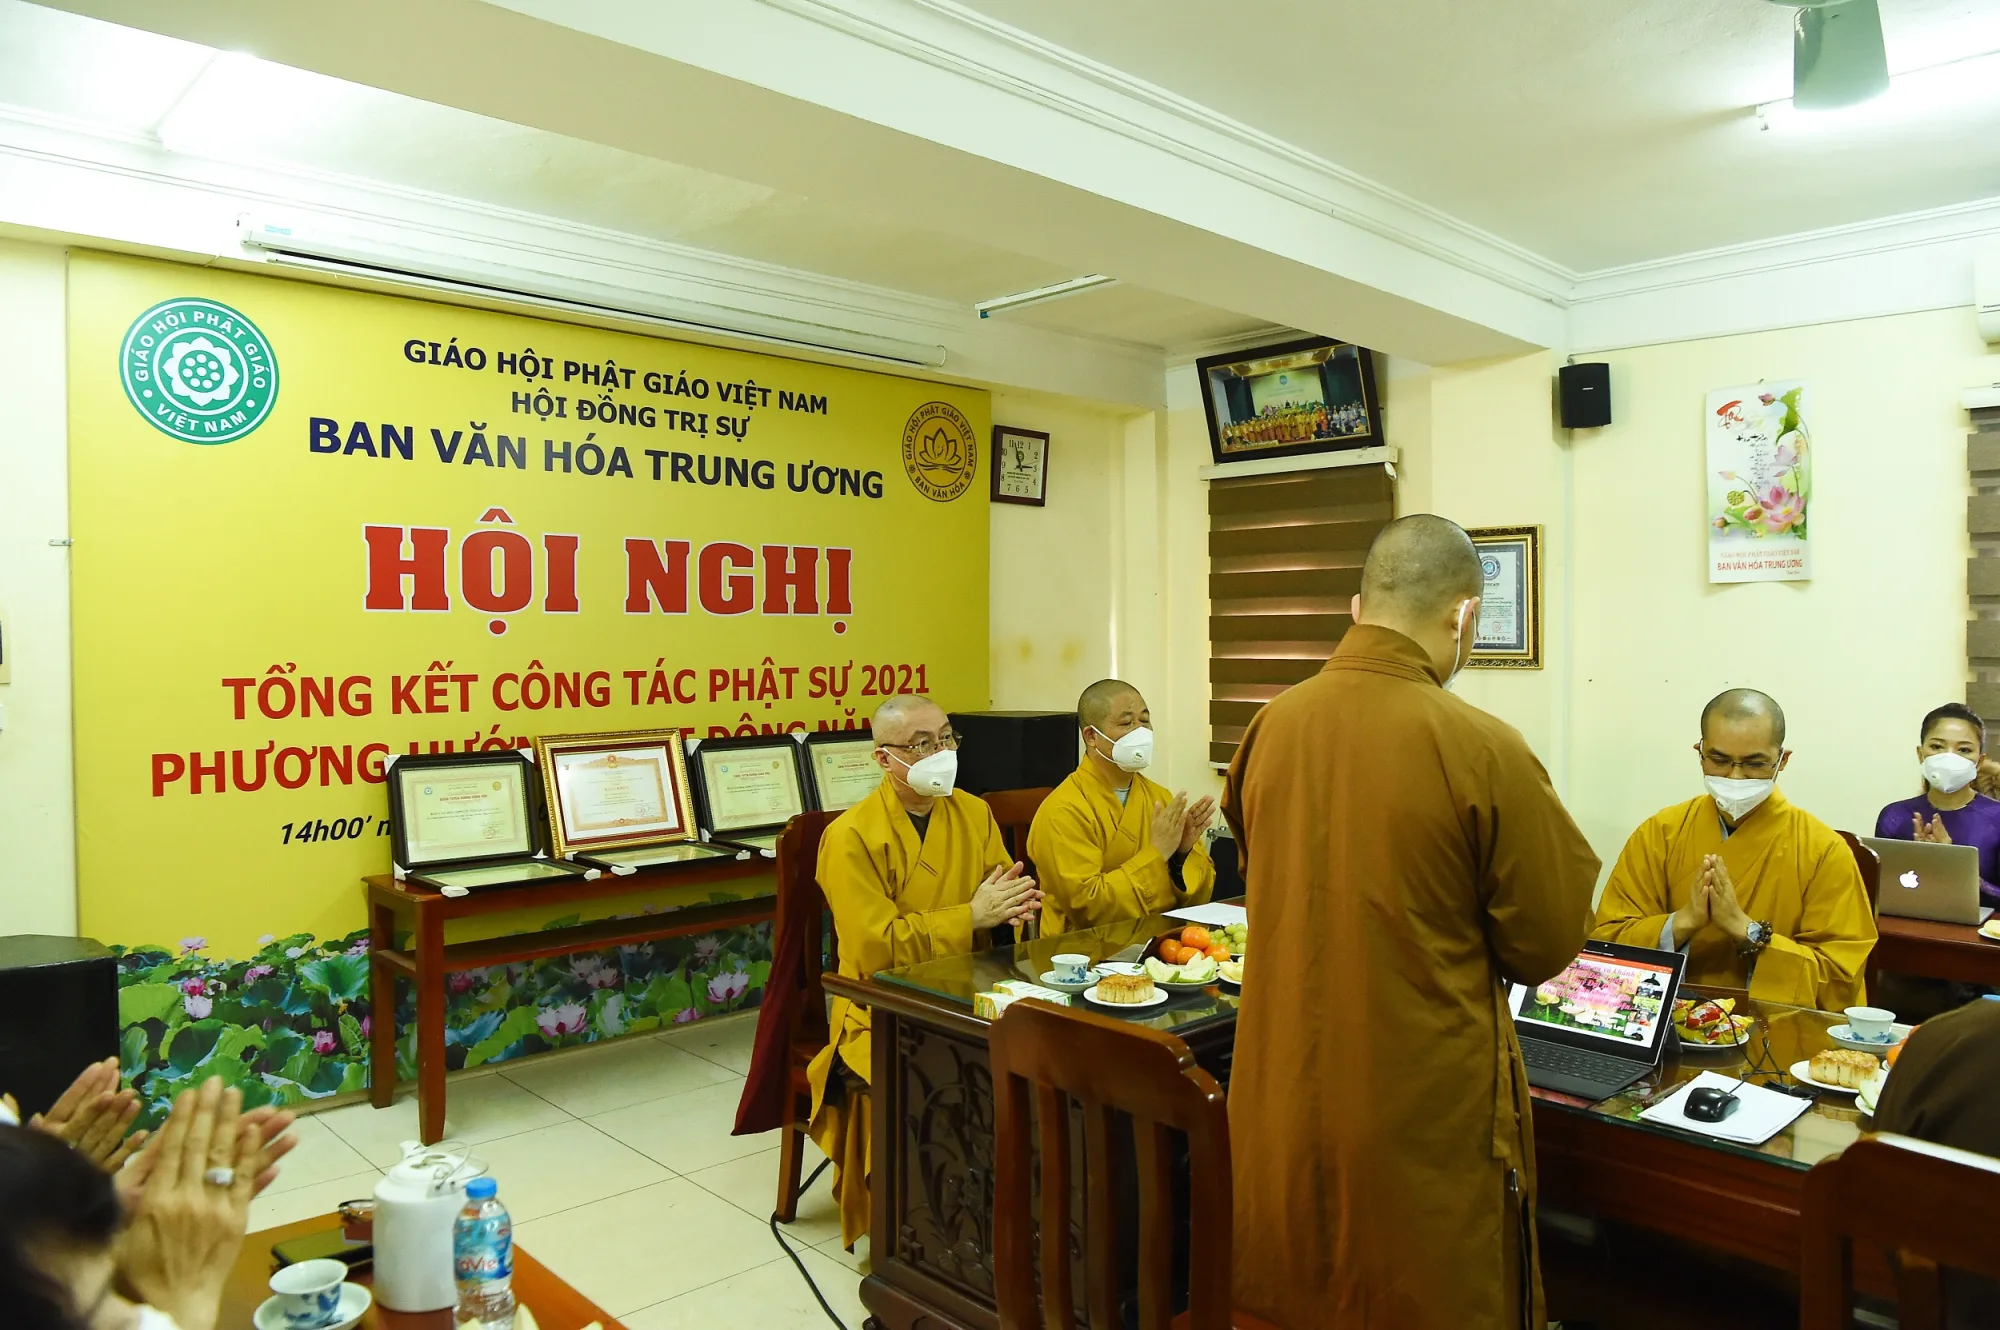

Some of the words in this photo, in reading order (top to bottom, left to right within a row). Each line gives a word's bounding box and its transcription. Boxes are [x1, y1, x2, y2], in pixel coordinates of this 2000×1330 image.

[131, 335, 155, 382] GIÁO
[152, 310, 187, 334] HỘI
[193, 310, 246, 339] PHẬT
[244, 343, 270, 389] GIÁO
[403, 336, 487, 371] GIÁO
[497, 347, 554, 383] HỘI
[563, 359, 637, 393] PHẬT
[643, 369, 710, 400] GIÁO
[716, 379, 772, 411] VIỆT
[778, 389, 828, 415] NAM
[156, 402, 200, 431] VIỆT
[203, 410, 247, 434] NAM
[511, 387, 568, 422] HỘI
[575, 393, 656, 428] ĐỒNG
[663, 408, 709, 438] TRỊ
[715, 415, 751, 443] SỰ
[920, 405, 939, 418] PHẬT
[941, 407, 959, 422] GIÁO
[309, 416, 414, 461] BAN
[429, 420, 528, 471] VĂN
[543, 432, 634, 479] HÓA
[644, 448, 775, 490] TRUNG
[786, 459, 883, 499] ƯƠNG
[915, 476, 930, 493] BAN
[950, 482, 965, 496] HÓA
[364, 507, 579, 636] HỘI
[623, 536, 853, 636] NGHỊ
[1717, 562, 1732, 571] BAN
[1764, 559, 1786, 569] TRUNG
[221, 661, 372, 720] TỔNG
[390, 660, 479, 715] KẾT
[492, 659, 611, 711] CÔNG
[622, 657, 697, 706] TÁC
[708, 656, 800, 709] PHẬT
[807, 659, 855, 706] SỰ
[861, 663, 930, 696] 2021
[151, 740, 389, 798] PHƯƠNG
